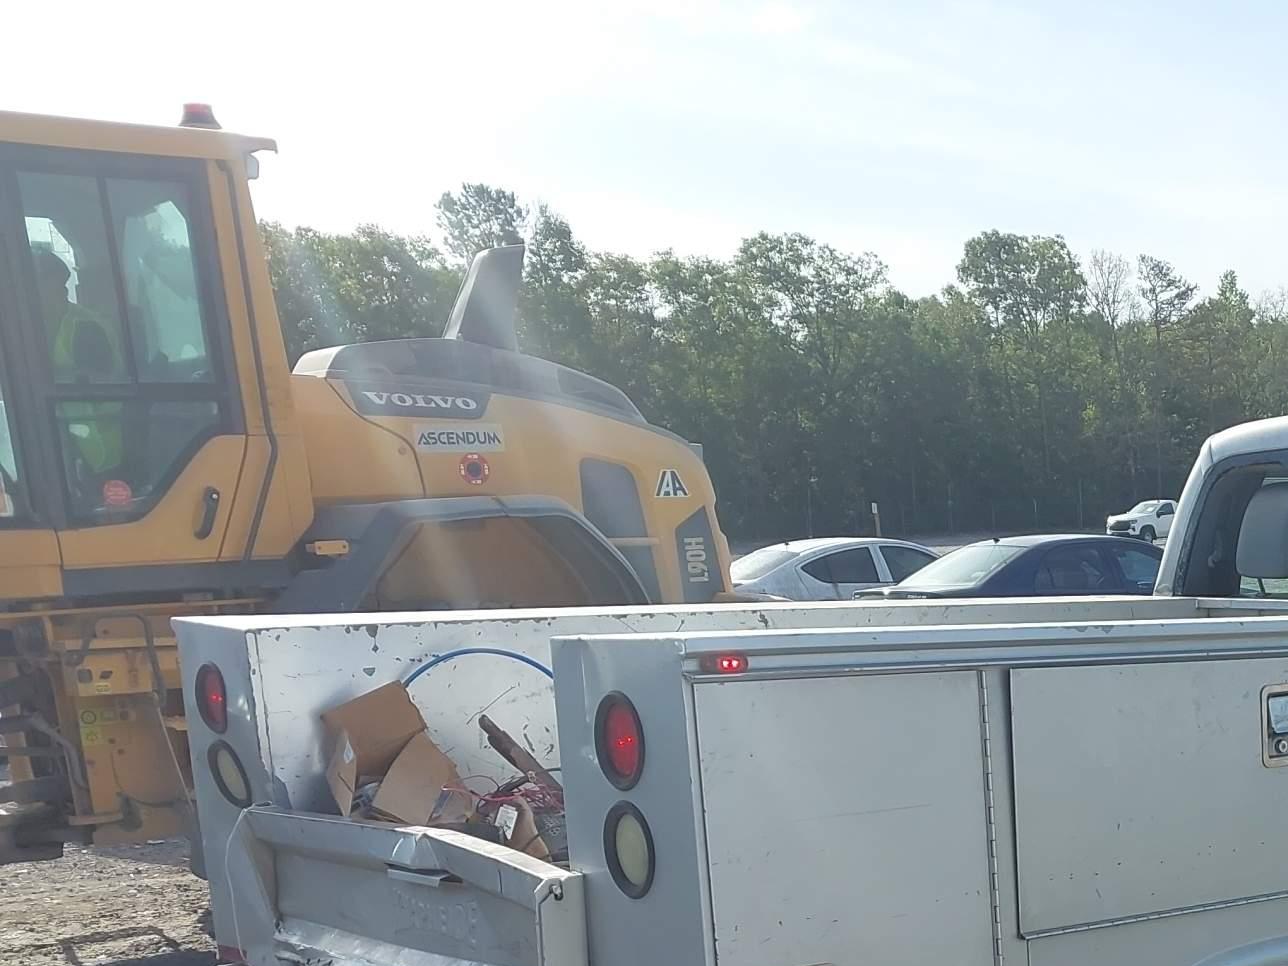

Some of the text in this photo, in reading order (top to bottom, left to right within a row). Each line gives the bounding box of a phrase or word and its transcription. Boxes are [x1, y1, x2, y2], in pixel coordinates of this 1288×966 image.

[362, 391, 478, 410] VOLVO
[417, 431, 502, 445] ASCENDUM
[683, 536, 710, 583] L90H
